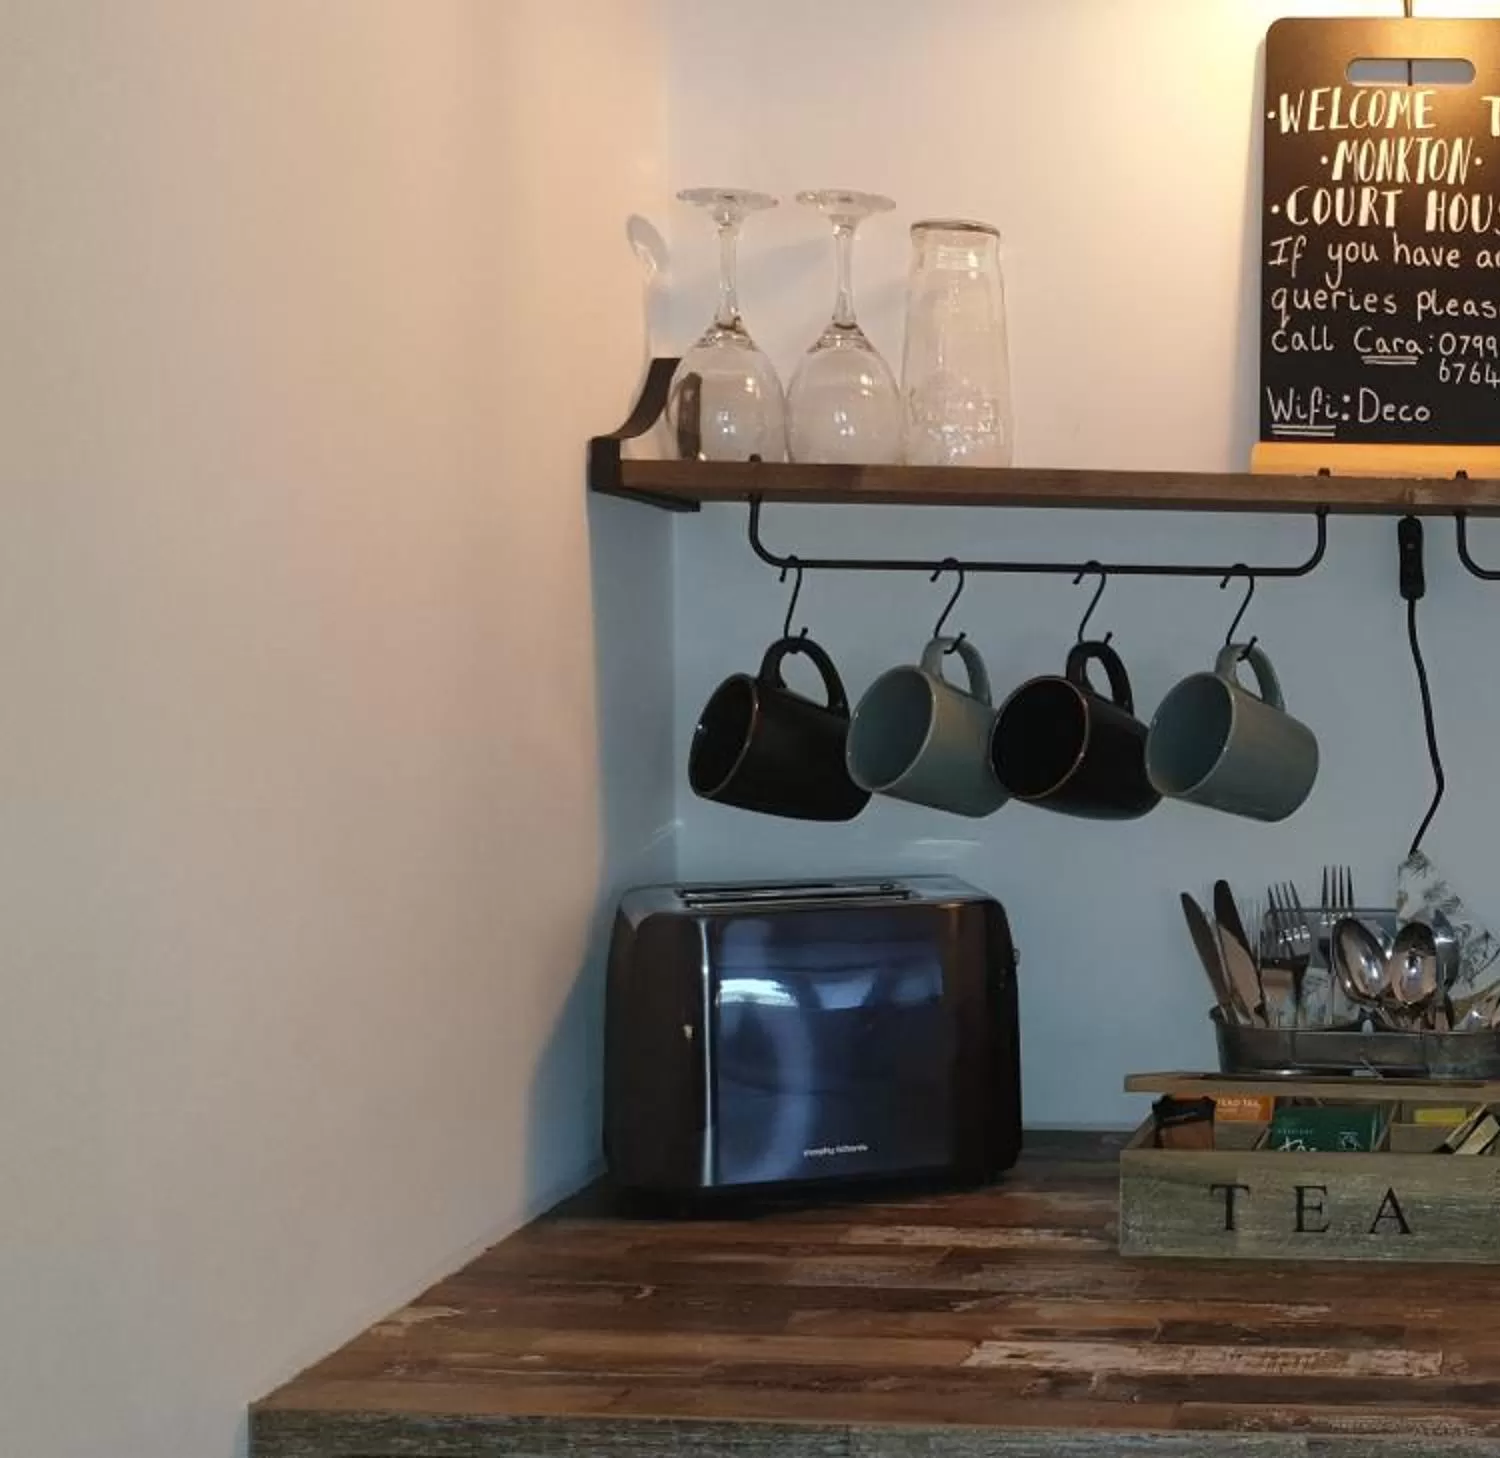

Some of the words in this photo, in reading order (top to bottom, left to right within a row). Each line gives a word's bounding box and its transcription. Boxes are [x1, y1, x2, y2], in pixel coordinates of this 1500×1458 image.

[1279, 87, 1438, 133] WELCOME
[1331, 136, 1474, 185] MONKTON
[1286, 186, 1403, 228] COURT
[1268, 235, 1307, 278] If
[1325, 241, 1380, 289] you
[1393, 231, 1461, 269] have
[1271, 287, 1398, 328] queries
[1271, 325, 1335, 353] call
[1358, 387, 1431, 424] Deco
[1210, 1184, 1412, 1235] TEA
